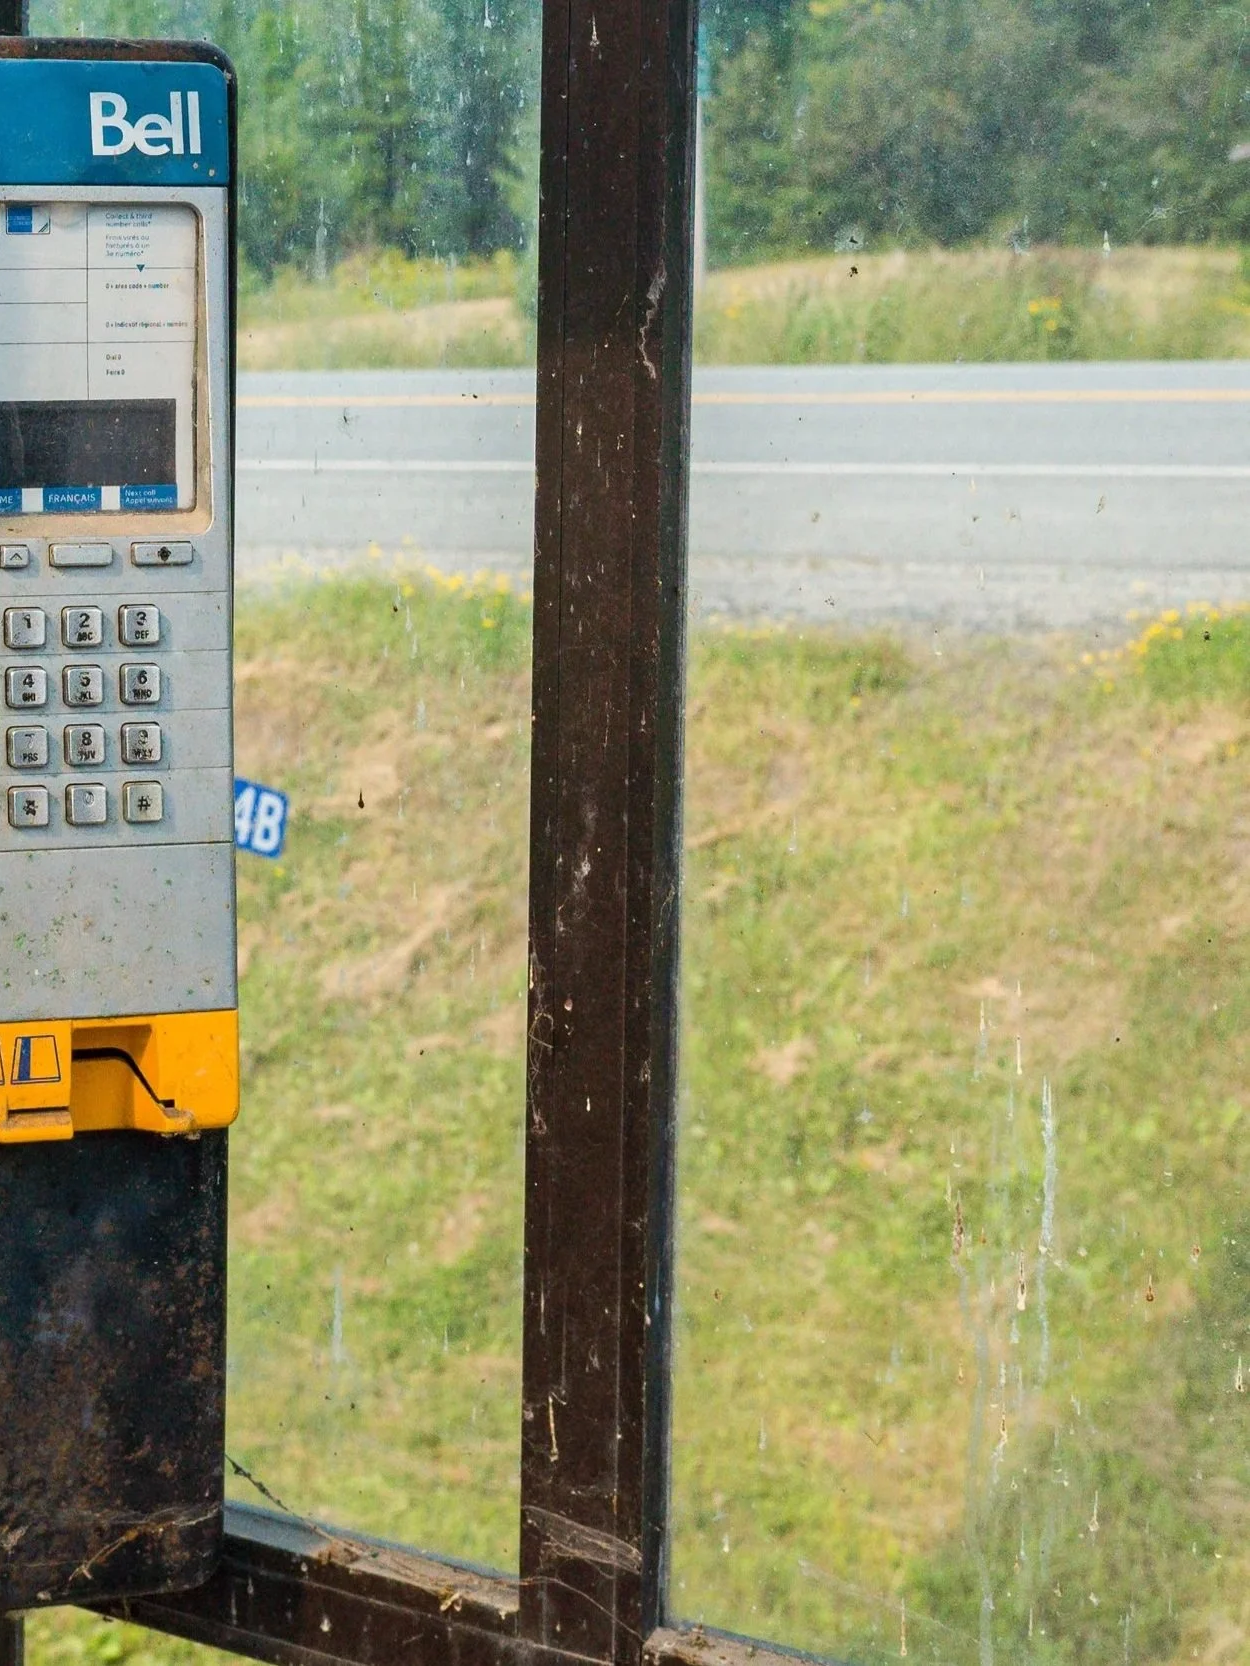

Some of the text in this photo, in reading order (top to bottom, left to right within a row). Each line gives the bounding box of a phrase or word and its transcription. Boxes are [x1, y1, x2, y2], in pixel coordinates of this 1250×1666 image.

[90, 91, 202, 156] Bell
[48, 494, 96, 504] FRANÇAIS
[126, 496, 146, 504] Appel
[23, 613, 32, 629] 1
[79, 612, 90, 628] 2
[136, 611, 148, 626] 3
[76, 632, 94, 642] ABC
[134, 630, 150, 640] DEF
[22, 673, 35, 688] 4
[80, 672, 92, 687] 5
[137, 670, 148, 684] 6
[78, 691, 93, 702] JKL
[81, 731, 93, 746] 8
